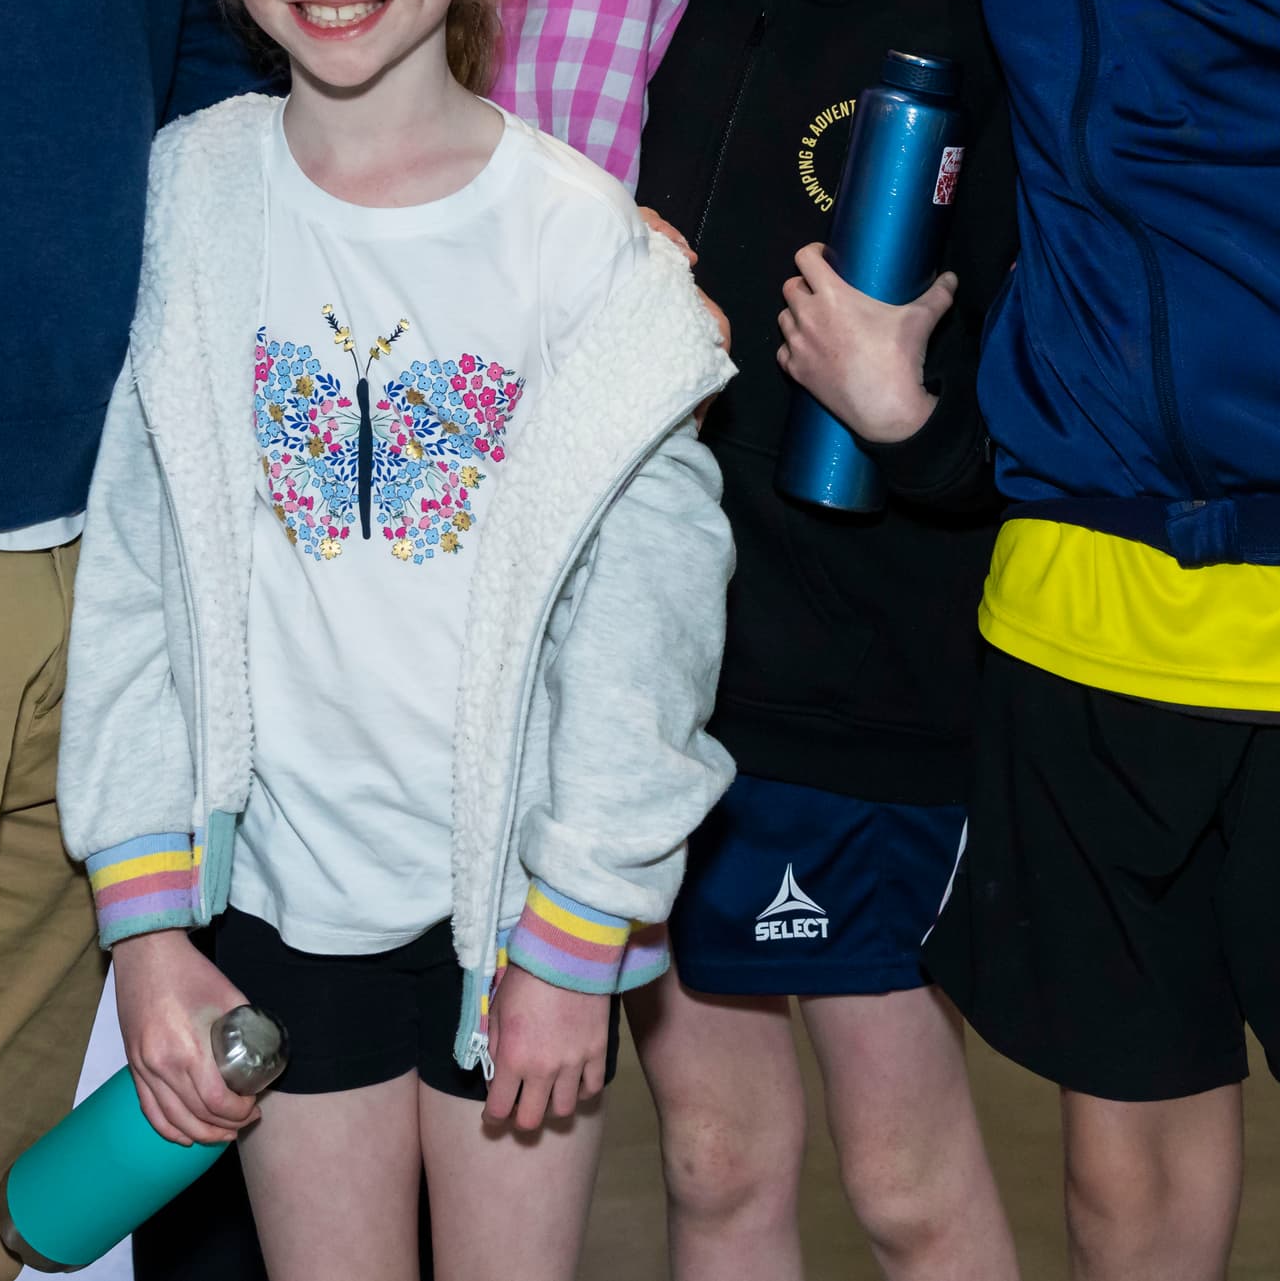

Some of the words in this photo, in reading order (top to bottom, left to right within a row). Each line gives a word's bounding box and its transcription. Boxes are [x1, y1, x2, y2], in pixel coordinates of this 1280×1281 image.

[801, 136, 818, 148] &
[798, 150, 834, 212] CAMPING
[754, 918, 830, 942] SELECT
